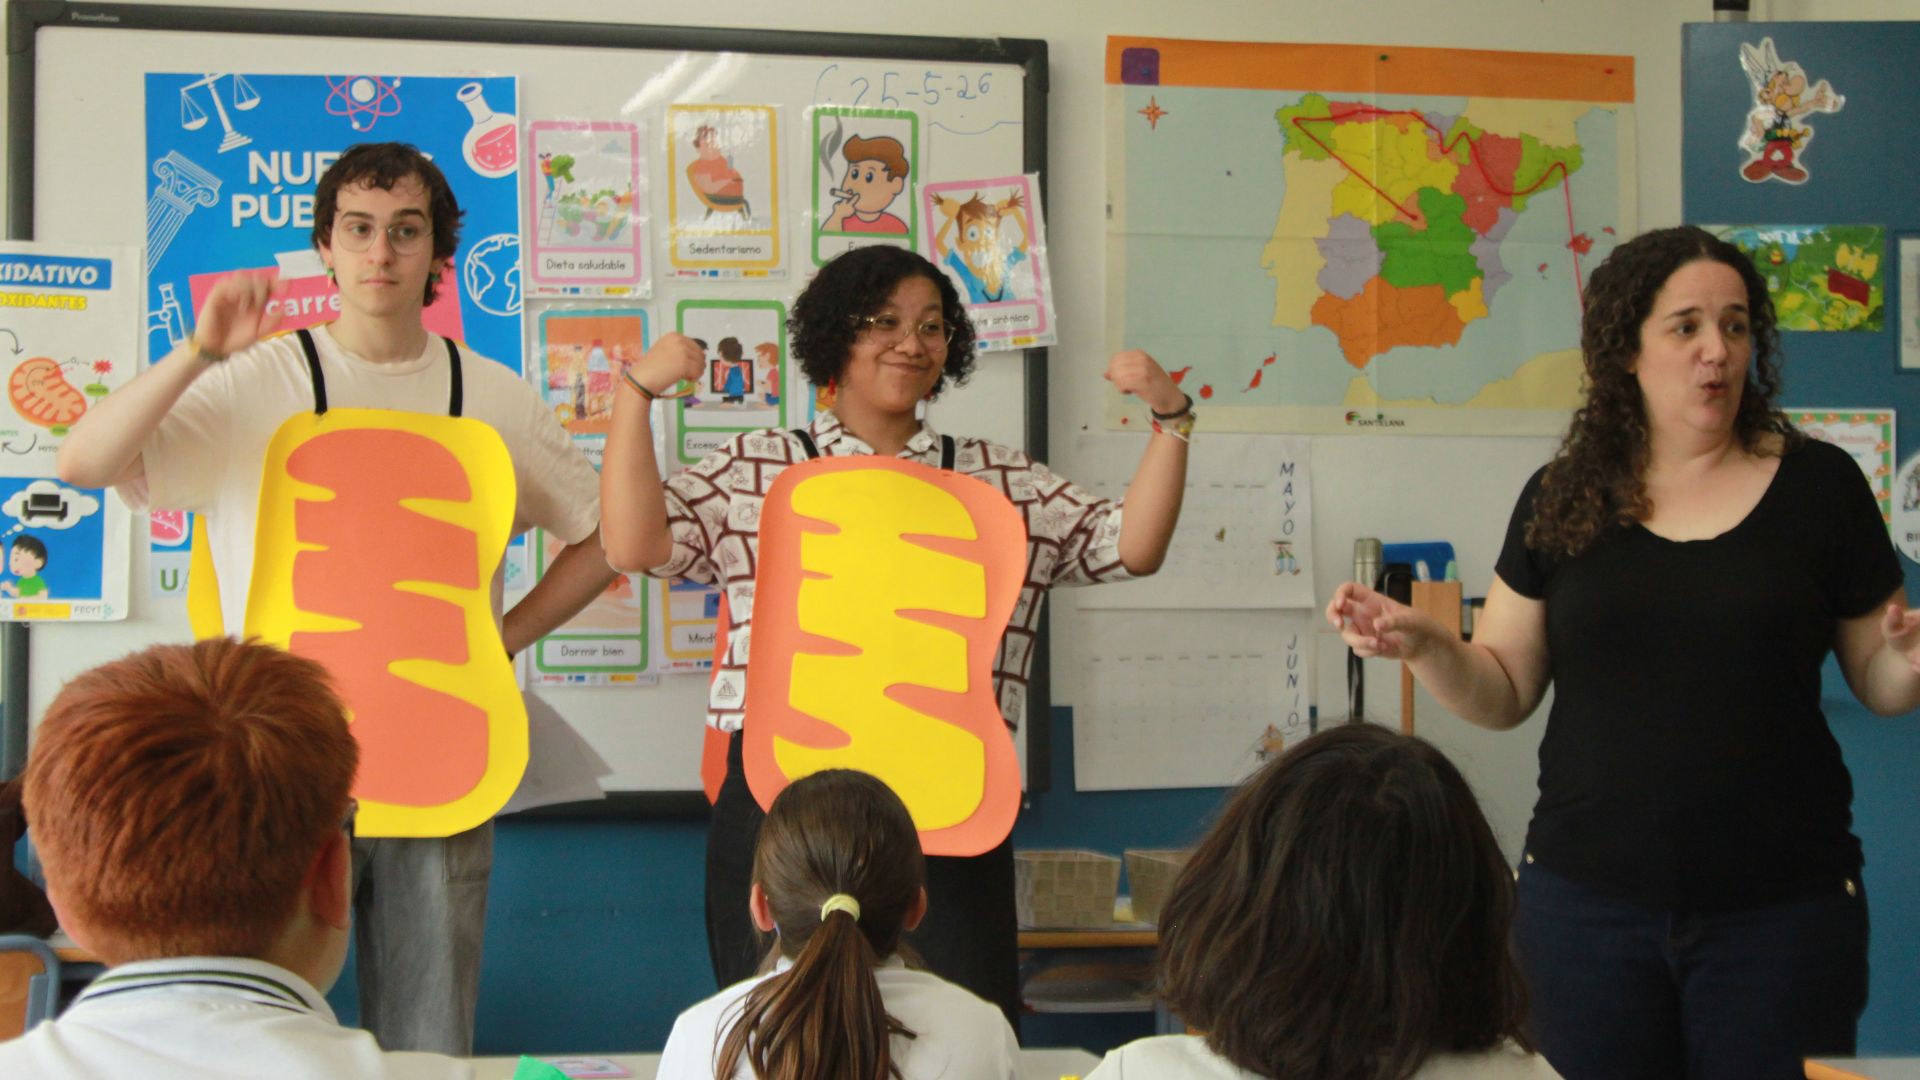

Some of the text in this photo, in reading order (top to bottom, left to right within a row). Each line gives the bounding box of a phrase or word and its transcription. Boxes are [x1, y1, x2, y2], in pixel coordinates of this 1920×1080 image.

[231, 185, 316, 228] PÚB
[688, 243, 762, 256] Sedentarismo
[546, 257, 626, 271] Dieta saludable
[265, 294, 342, 318] carre
[686, 439, 719, 450] Exceso
[1279, 461, 1295, 536] MAYO
[688, 633, 715, 644] Mind
[561, 644, 624, 657] Dormir bien
[1285, 634, 1300, 728] JUNIO
